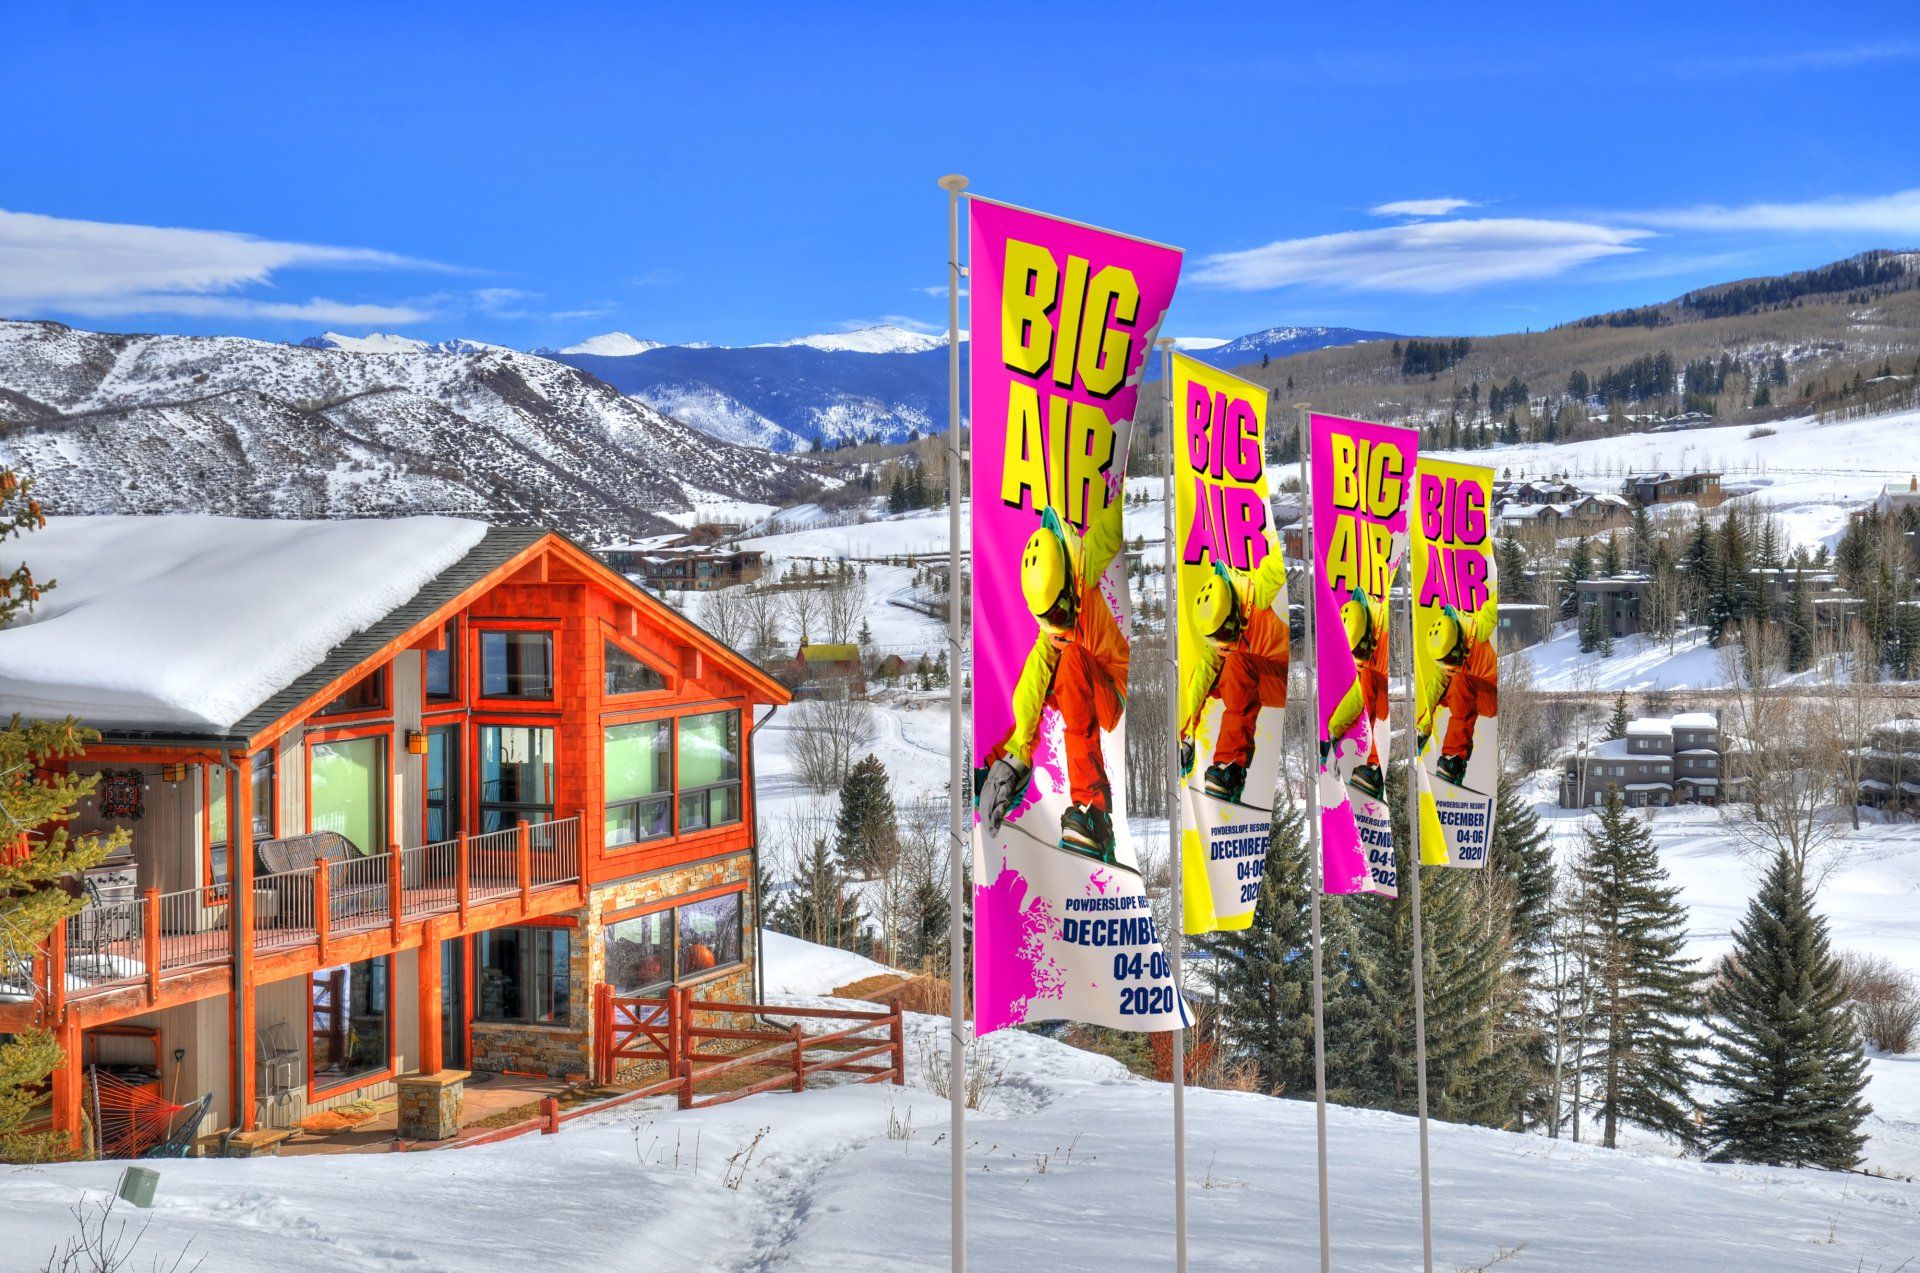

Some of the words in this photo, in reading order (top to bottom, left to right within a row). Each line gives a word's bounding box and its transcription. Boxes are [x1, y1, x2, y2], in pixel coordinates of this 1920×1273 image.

[1002, 237, 1140, 400] BIG
[1187, 380, 1263, 484] BIG
[1001, 379, 1116, 529] AIR
[1331, 433, 1404, 520] BIG
[1183, 476, 1269, 572] AIR
[1421, 473, 1487, 545] BIG
[1326, 514, 1393, 599] AIR
[1419, 543, 1489, 613] AIR
[1436, 800, 1469, 810] POWDERSLOPE
[1211, 824, 1249, 836] POWDERSLOPE
[1457, 829, 1484, 844] 04-06
[1459, 846, 1483, 860] 2020
[1371, 867, 1397, 888] 202
[1065, 896, 1137, 912] POWDERSLOPE
[1063, 917, 1160, 946] DECEMBE
[1114, 951, 1171, 981] 04-06
[1119, 986, 1174, 1015] 2020
